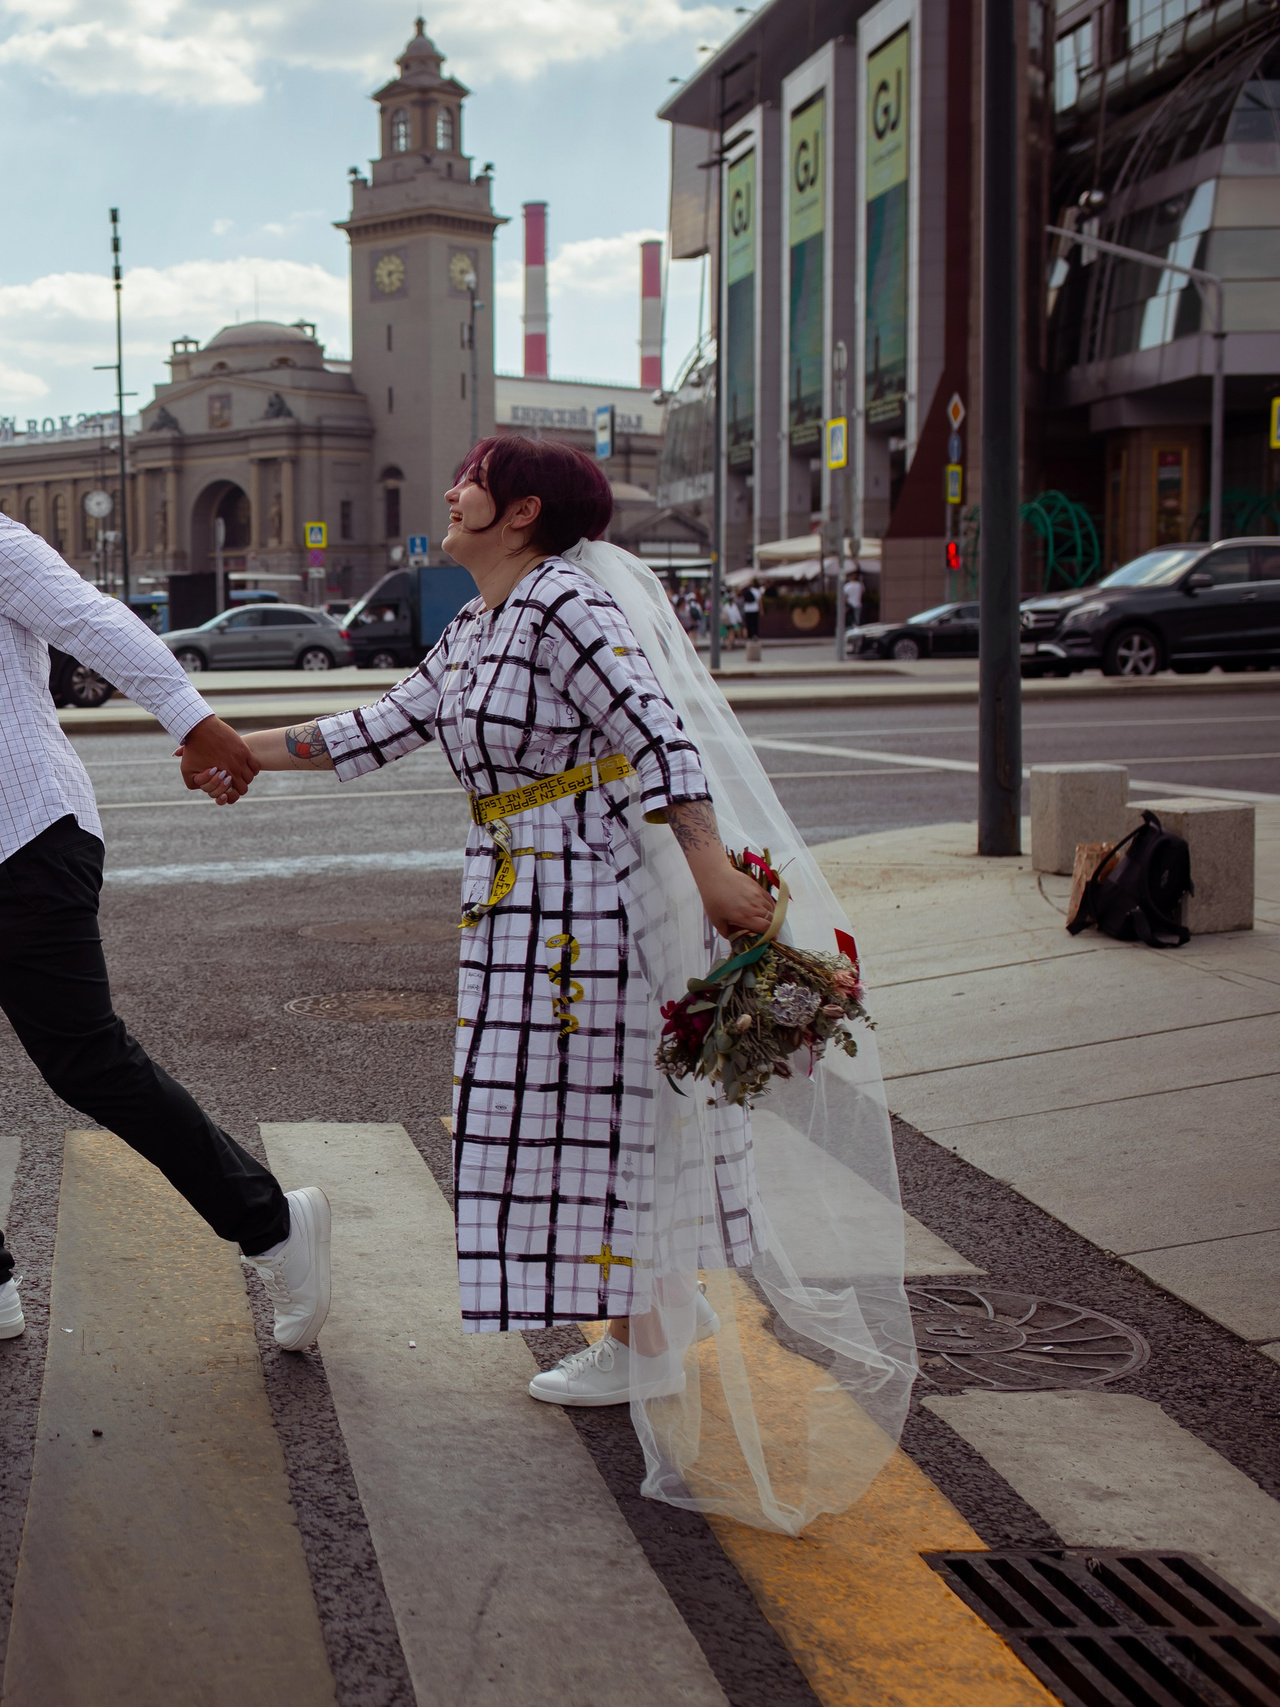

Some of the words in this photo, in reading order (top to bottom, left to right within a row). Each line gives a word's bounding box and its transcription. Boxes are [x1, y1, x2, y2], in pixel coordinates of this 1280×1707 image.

[874, 66, 902, 141] GJ
[794, 130, 820, 195] GJ
[731, 180, 752, 238] GJ
[479, 798, 501, 811] IRST
[505, 792, 521, 804] IN
[522, 776, 566, 798] SPACE
[498, 796, 538, 815] SPACE
[493, 858, 511, 897] FIRST
